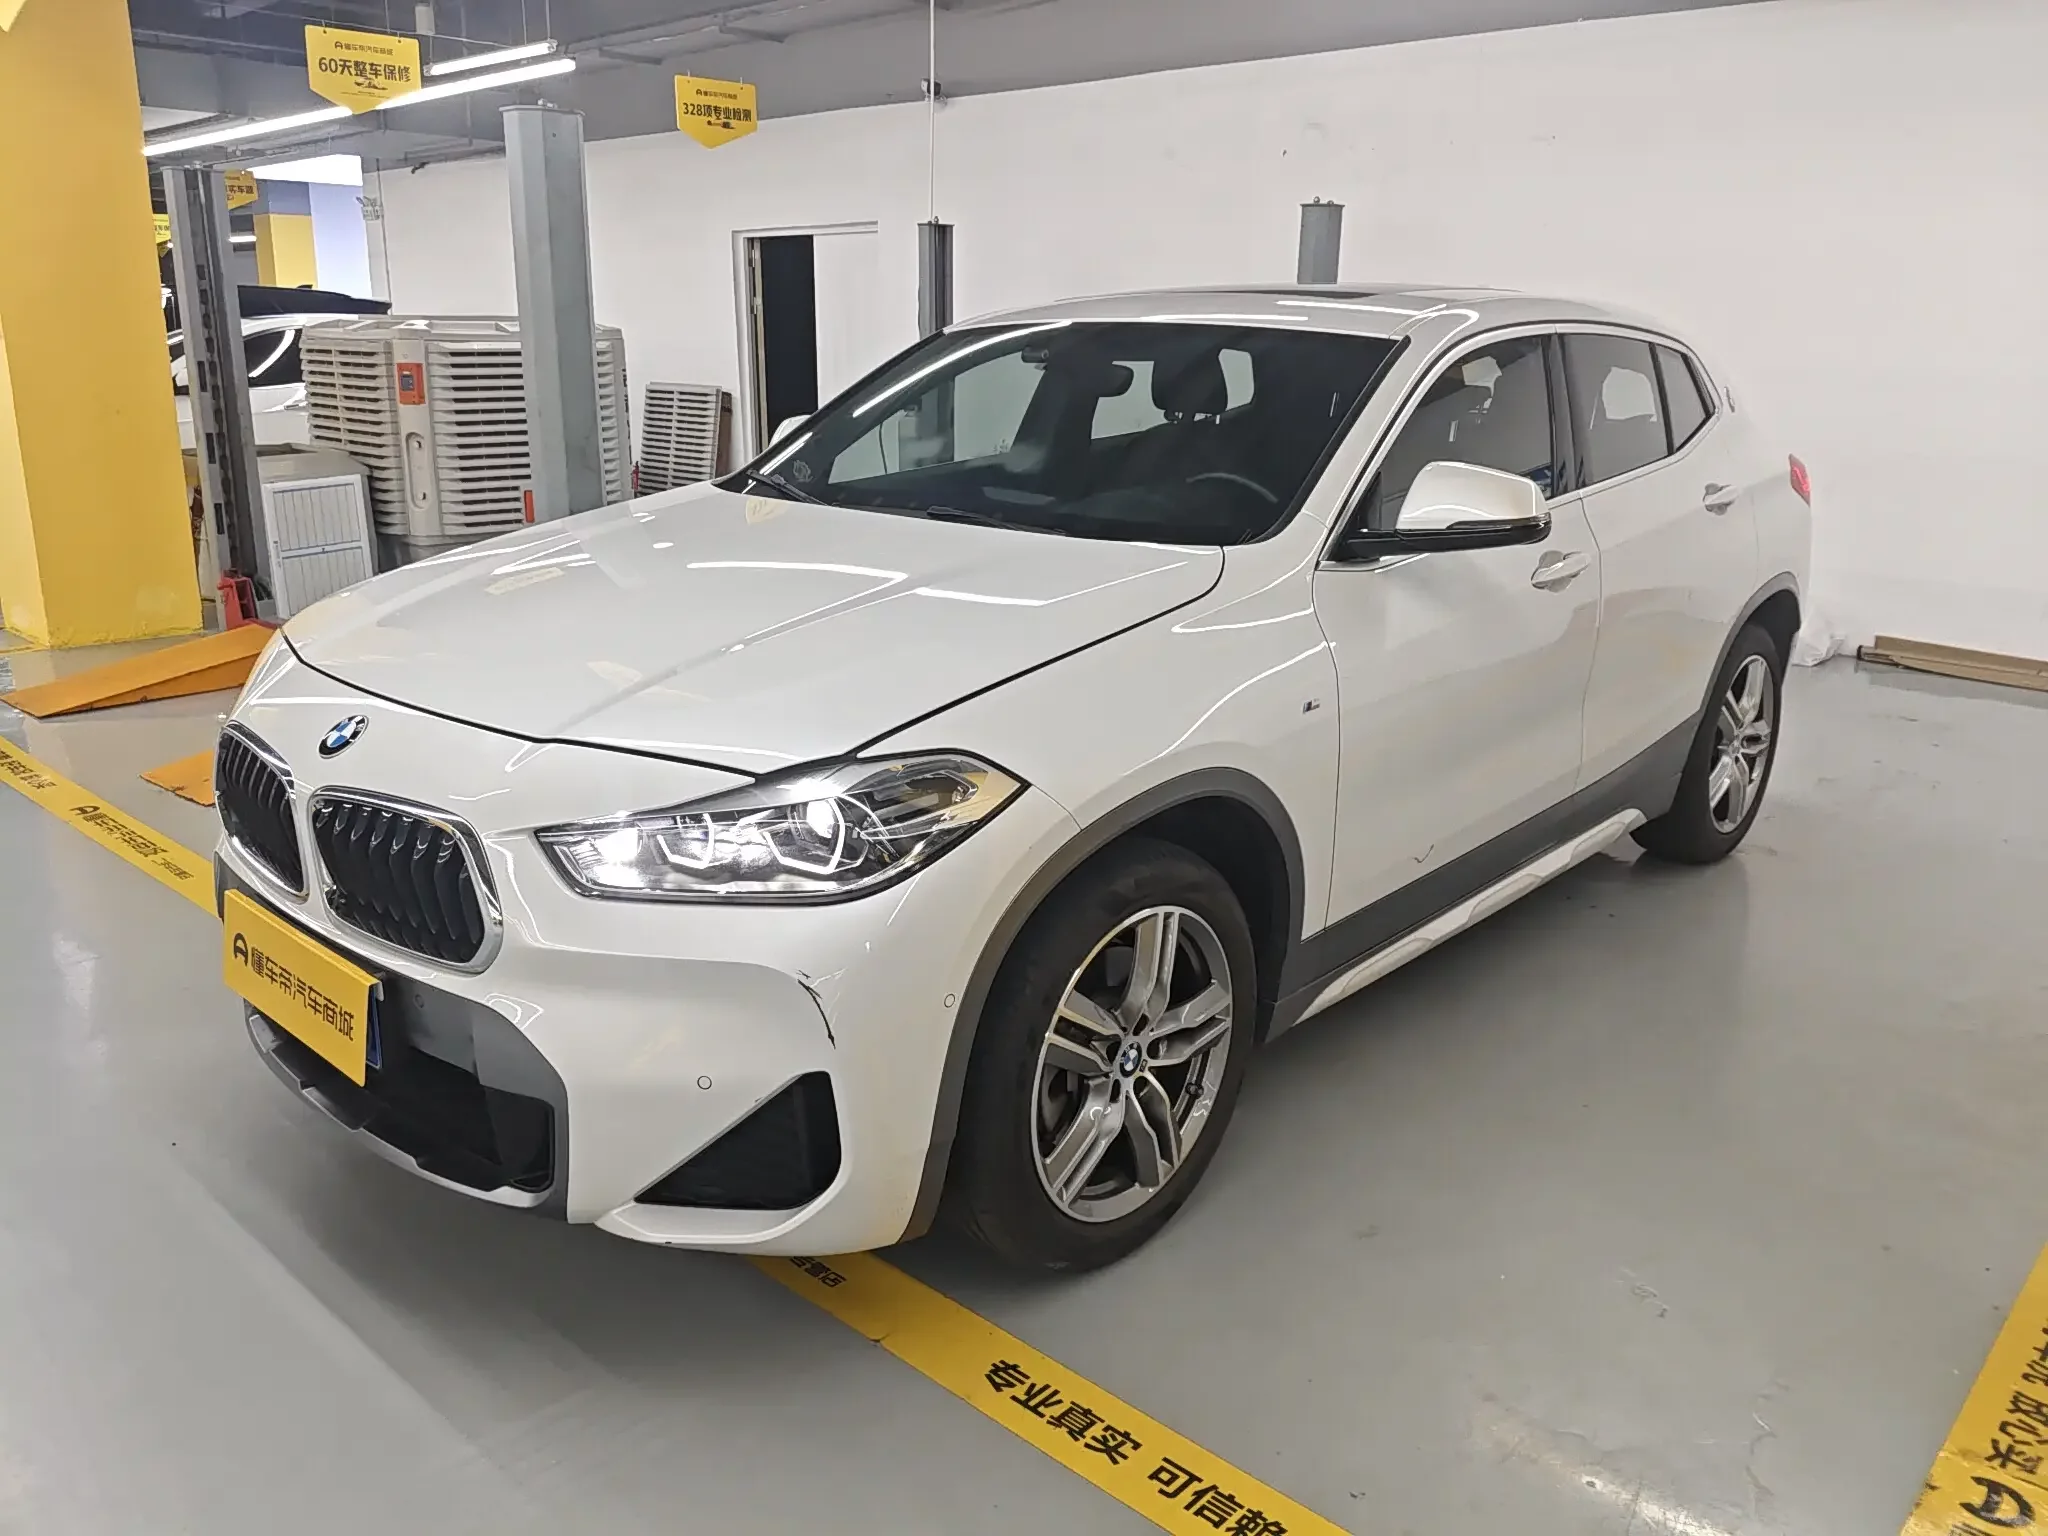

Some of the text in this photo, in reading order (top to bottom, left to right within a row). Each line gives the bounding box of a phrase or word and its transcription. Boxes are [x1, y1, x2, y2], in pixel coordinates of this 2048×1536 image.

[318, 57, 411, 82] 60天整车保修
[683, 103, 752, 122] 328项专业检测
[251, 947, 355, 1041] 懂车帝汽车商城
[984, 1359, 1142, 1465] 专业真实
